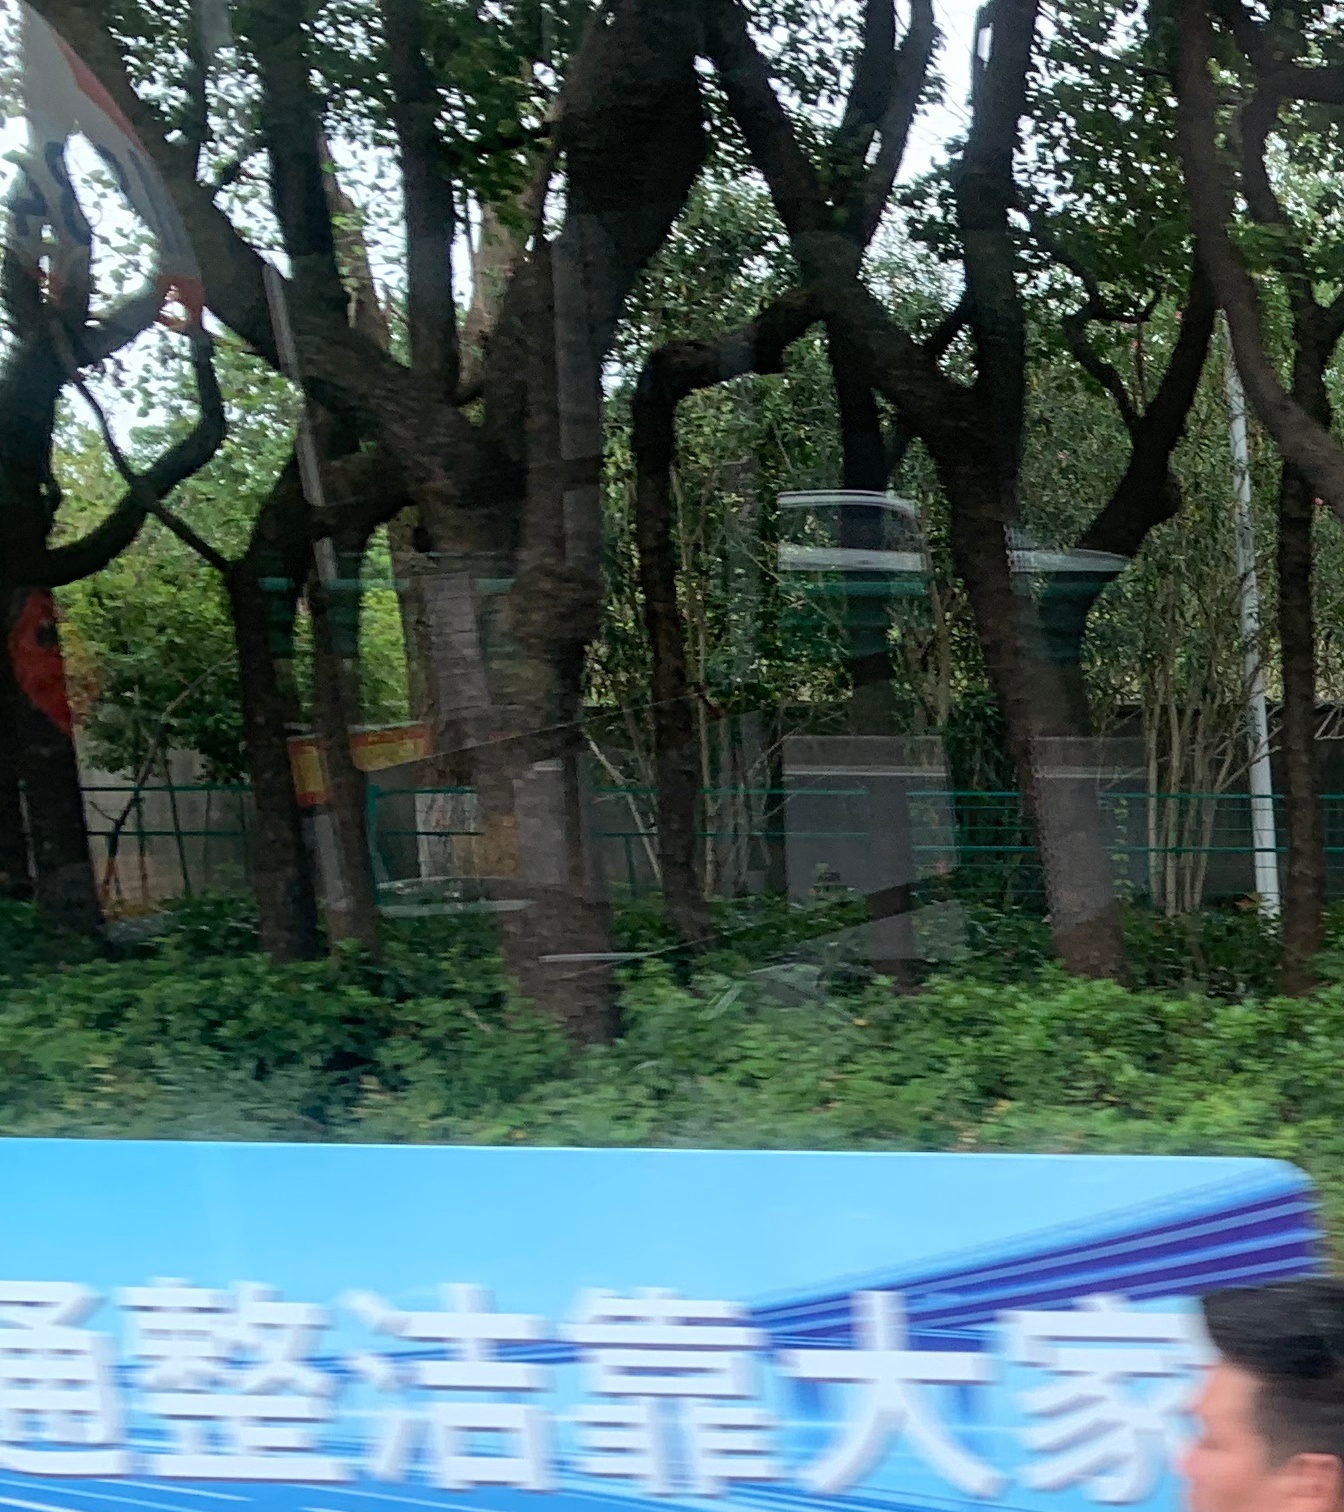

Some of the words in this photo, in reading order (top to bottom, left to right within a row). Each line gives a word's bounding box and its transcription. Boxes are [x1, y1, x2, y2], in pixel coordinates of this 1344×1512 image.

[0, 1277, 1218, 1505] 通整洁靠大家
